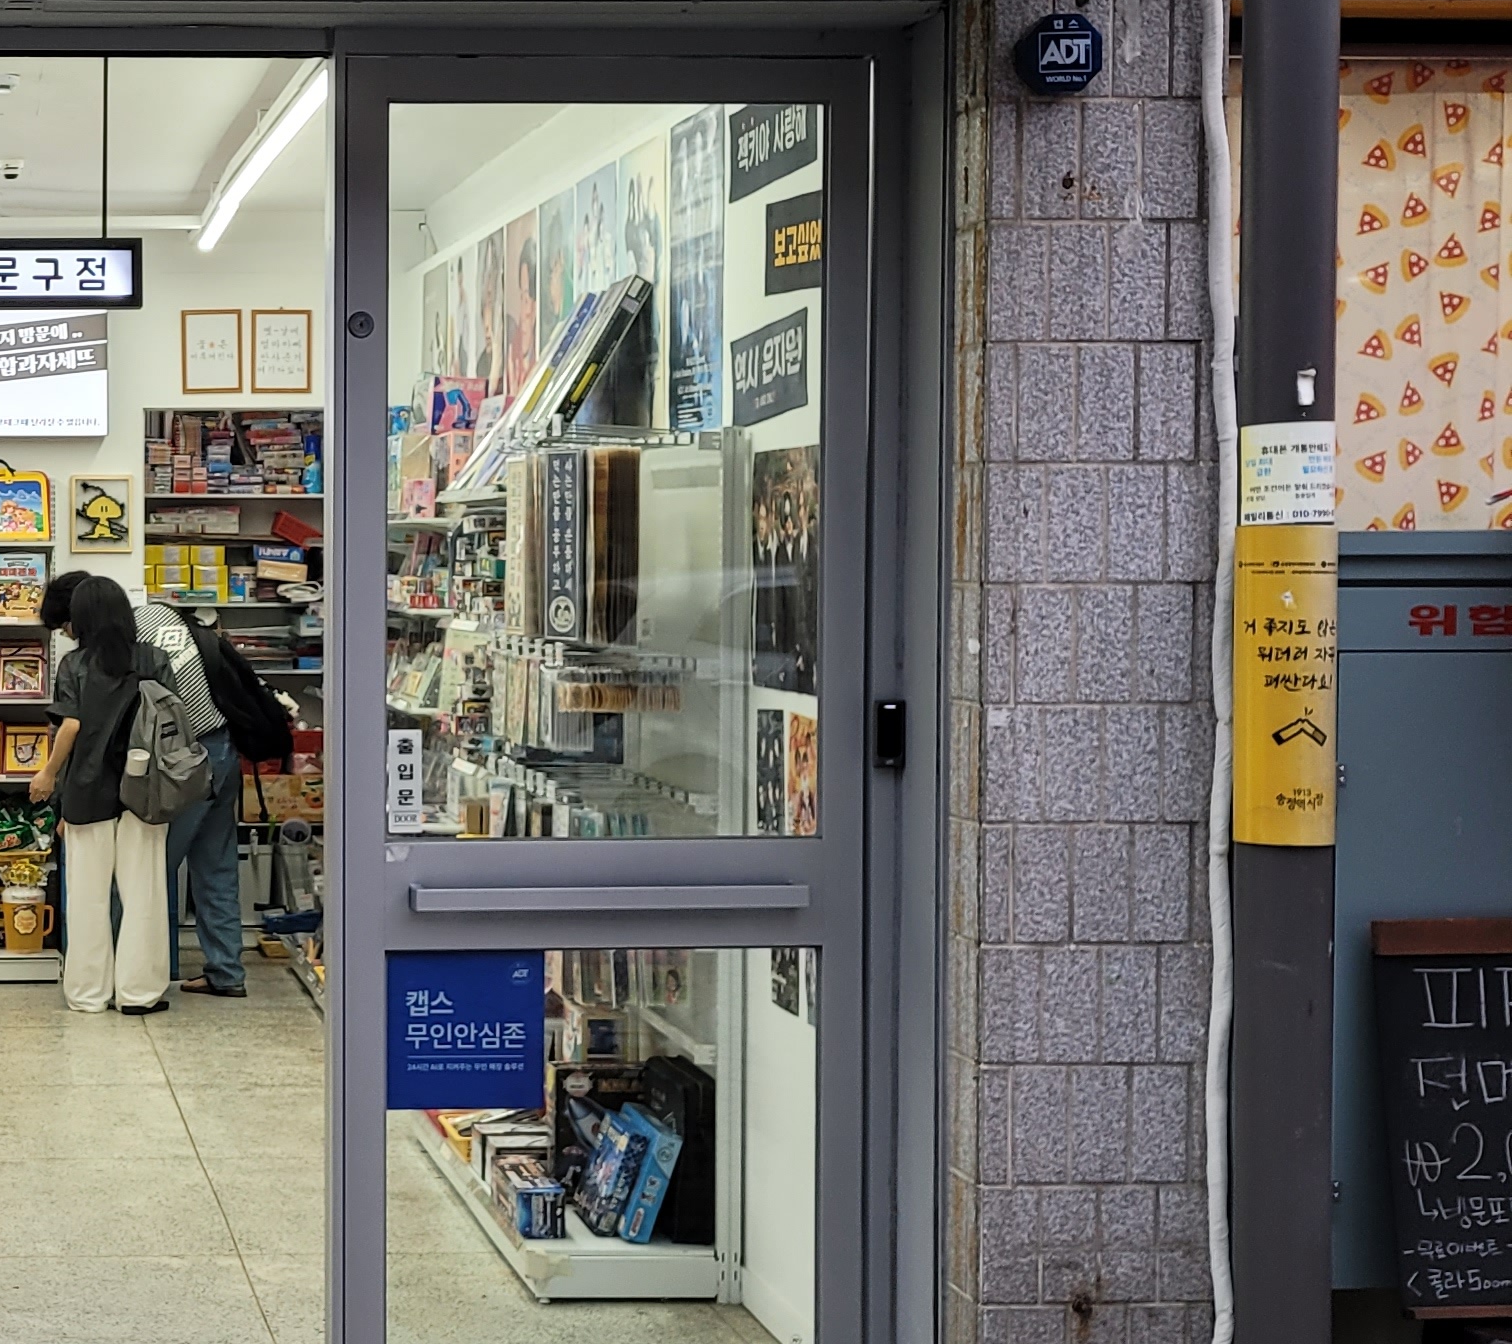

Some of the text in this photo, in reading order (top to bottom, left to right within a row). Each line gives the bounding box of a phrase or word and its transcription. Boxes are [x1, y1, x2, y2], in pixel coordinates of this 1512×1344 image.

[1040, 38, 1091, 66] ADT
[1045, 75, 1071, 83] WORLD
[734, 344, 759, 395] 역시
[761, 325, 803, 386] 은지원
[1408, 604, 1512, 637] 위험
[396, 737, 415, 806] 출입문
[404, 989, 455, 1018] 캡스
[404, 1021, 527, 1051] 무인안심존
